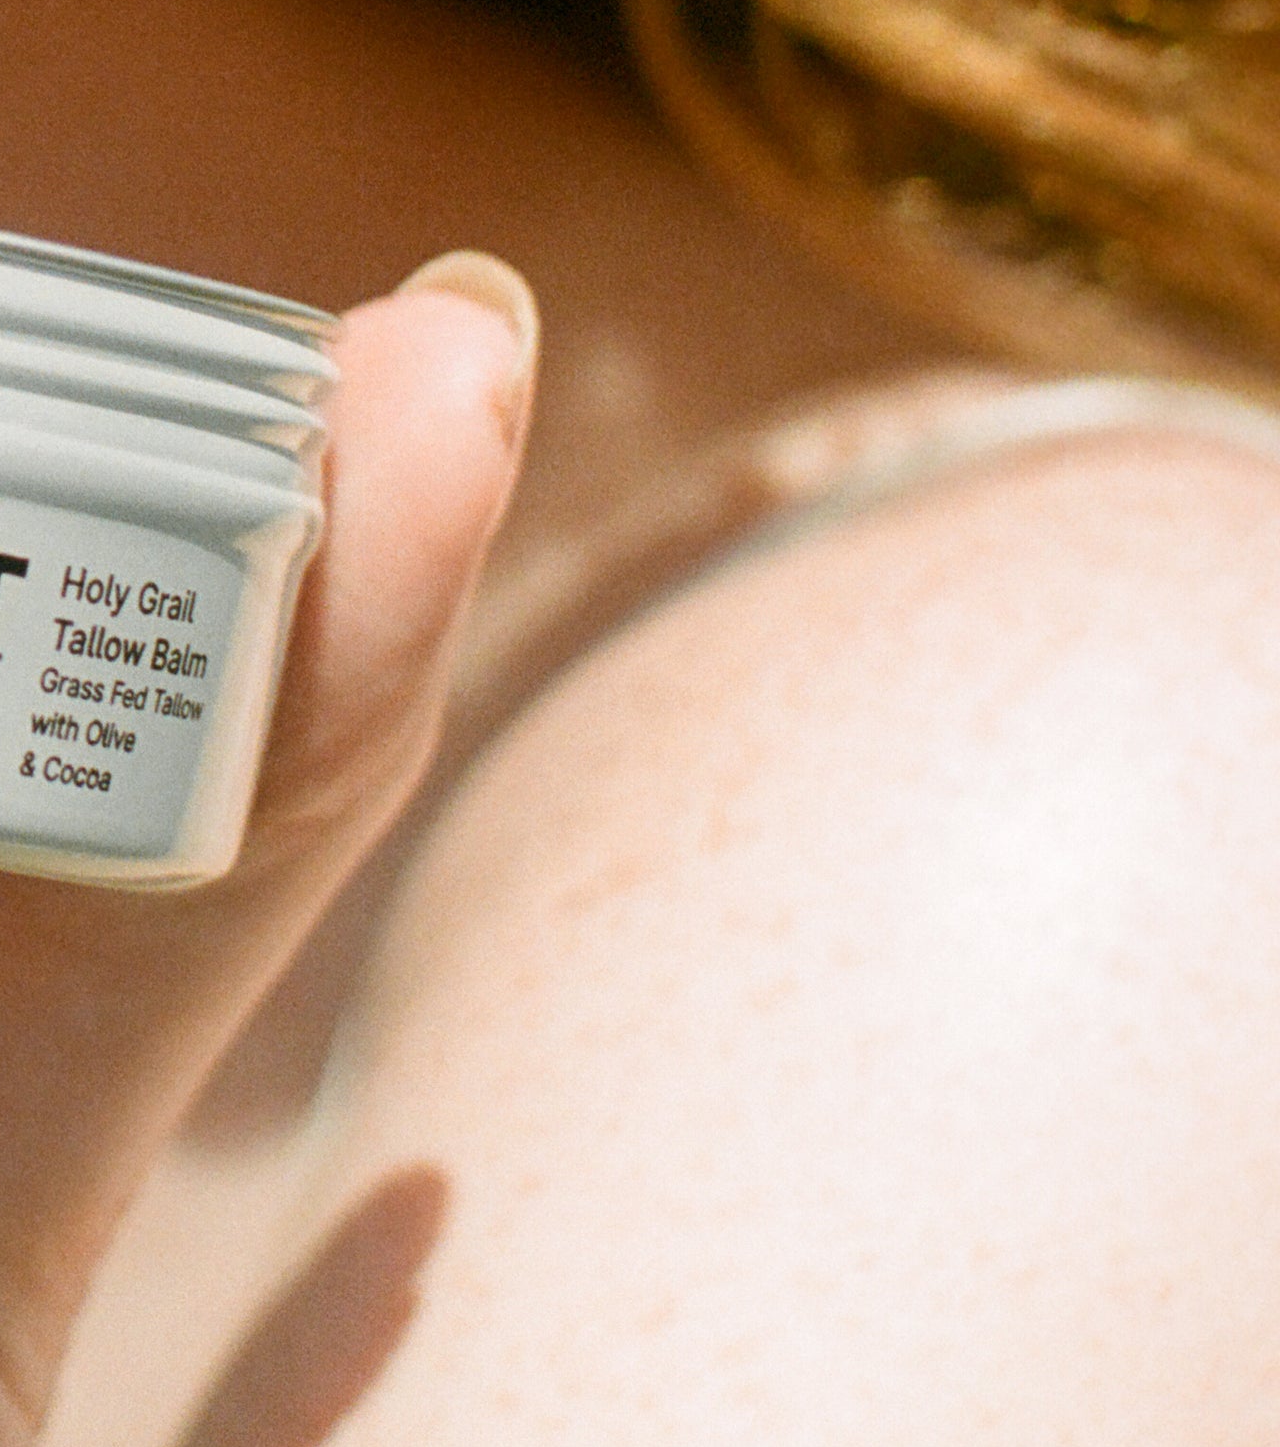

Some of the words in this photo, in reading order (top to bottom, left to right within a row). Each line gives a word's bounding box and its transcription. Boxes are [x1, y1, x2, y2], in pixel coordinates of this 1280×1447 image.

[61, 565, 131, 618] Holy
[138, 582, 196, 623] Grail
[54, 618, 146, 666] Tallow
[150, 637, 208, 679] Balm
[40, 667, 105, 703] Grass
[111, 679, 148, 711] Fed
[154, 688, 204, 722] Tallow
[31, 712, 80, 742] with
[86, 719, 136, 752] Olive
[19, 750, 36, 778] &
[43, 756, 112, 792] Cocoa
